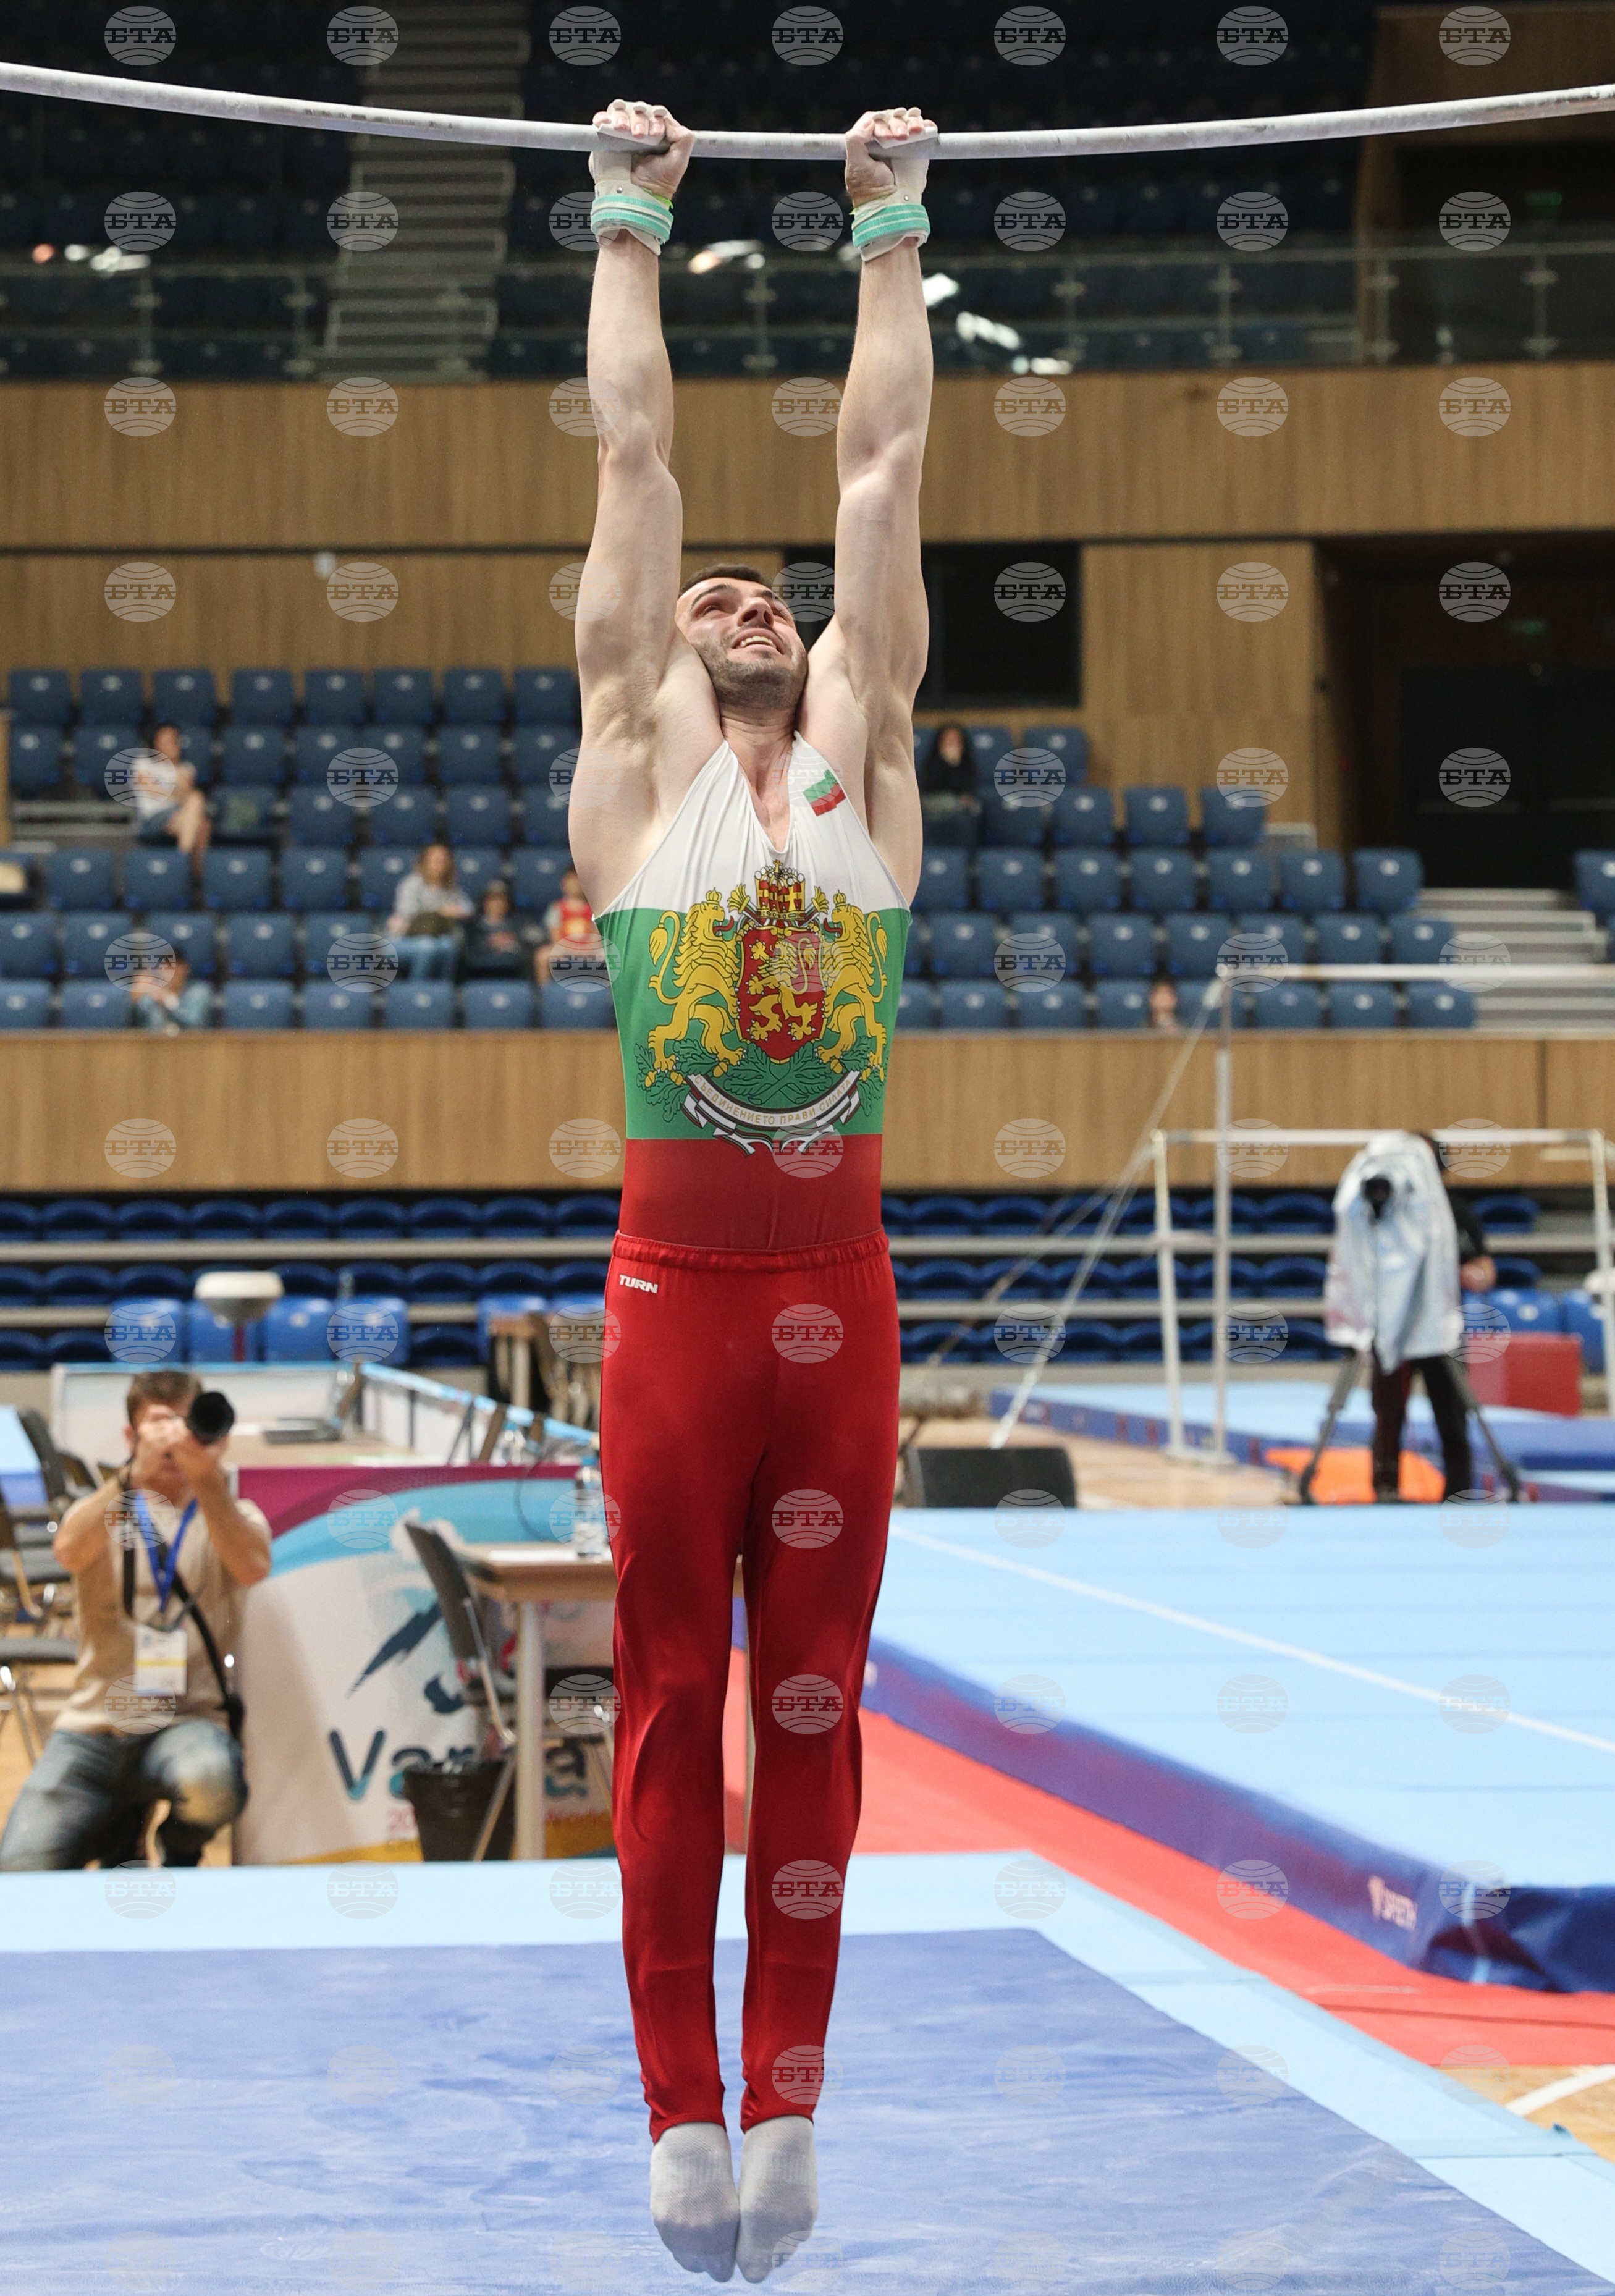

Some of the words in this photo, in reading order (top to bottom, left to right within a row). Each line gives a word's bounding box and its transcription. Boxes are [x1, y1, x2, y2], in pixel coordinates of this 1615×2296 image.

[694, 1074, 775, 1125] СЪЕДИНЕНИЕТО
[779, 1110, 816, 1125] ПРАВИ
[819, 1079, 851, 1112] СИЛАТА
[619, 1273, 659, 1294] TURN
